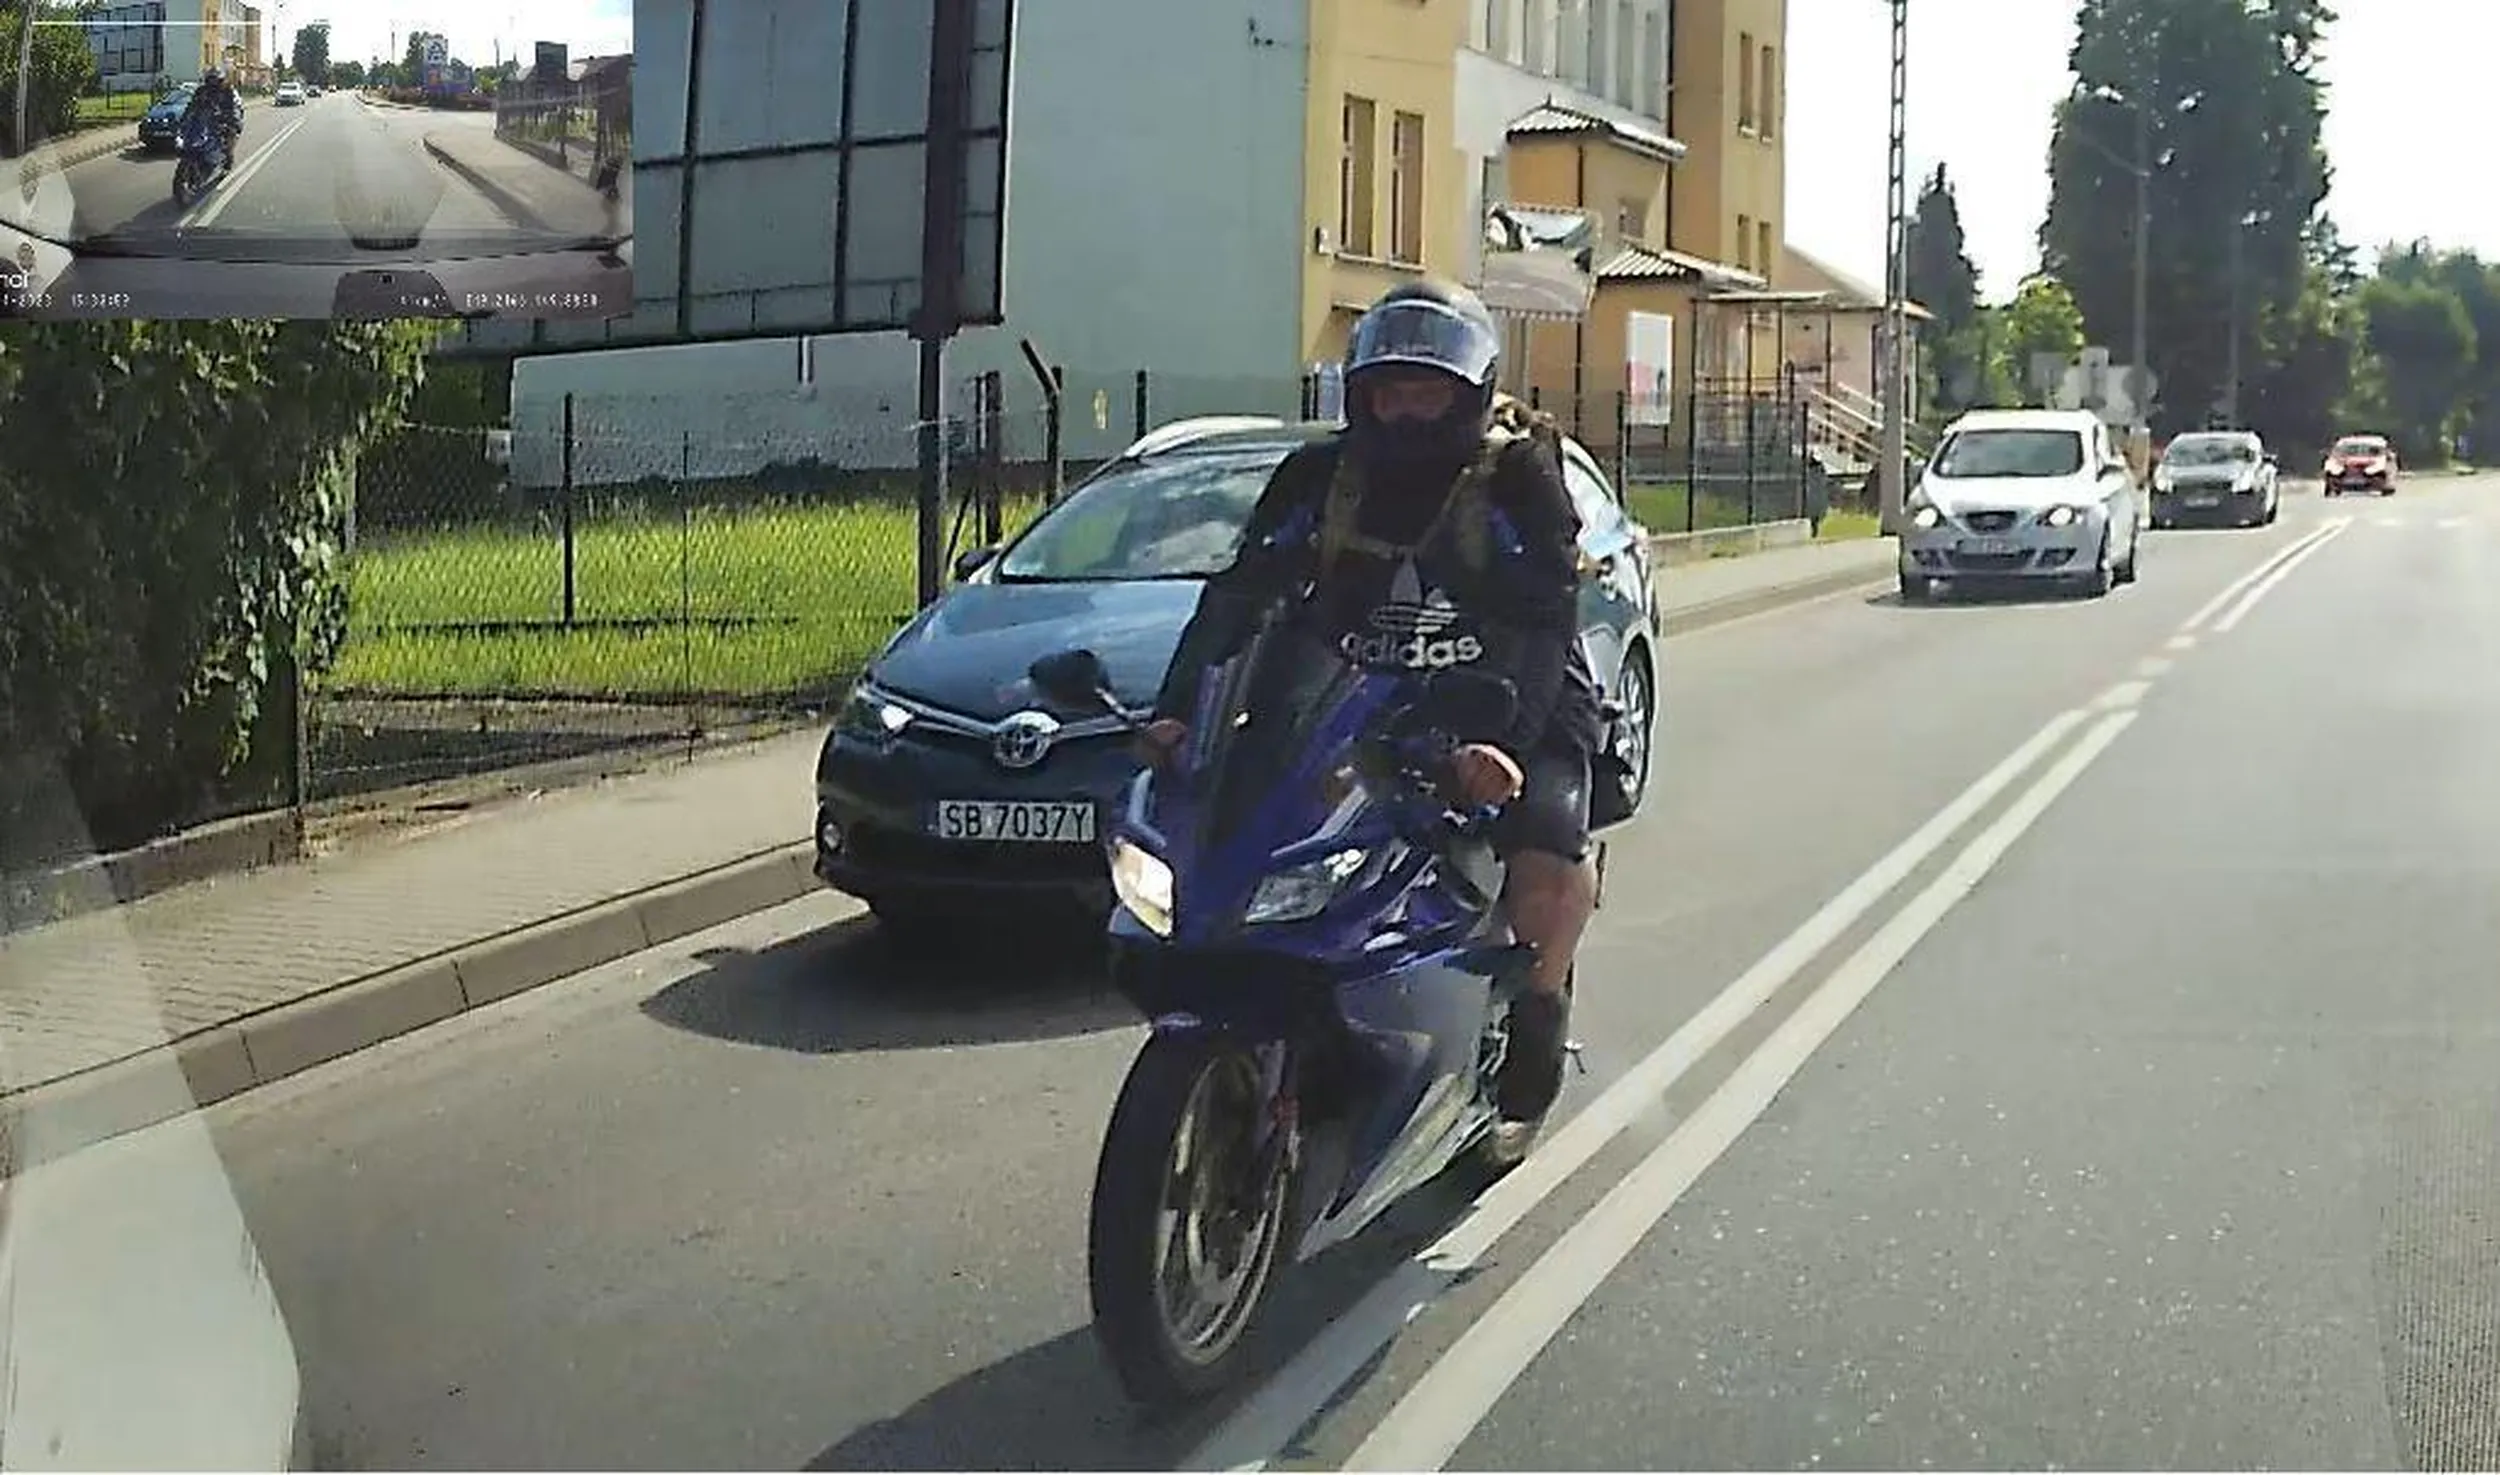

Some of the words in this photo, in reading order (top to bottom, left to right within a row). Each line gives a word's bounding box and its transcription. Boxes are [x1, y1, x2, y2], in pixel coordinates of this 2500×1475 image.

[1340, 632, 1483, 668] adidas
[946, 804, 982, 836] SB
[995, 805, 1087, 839] 7037Y
